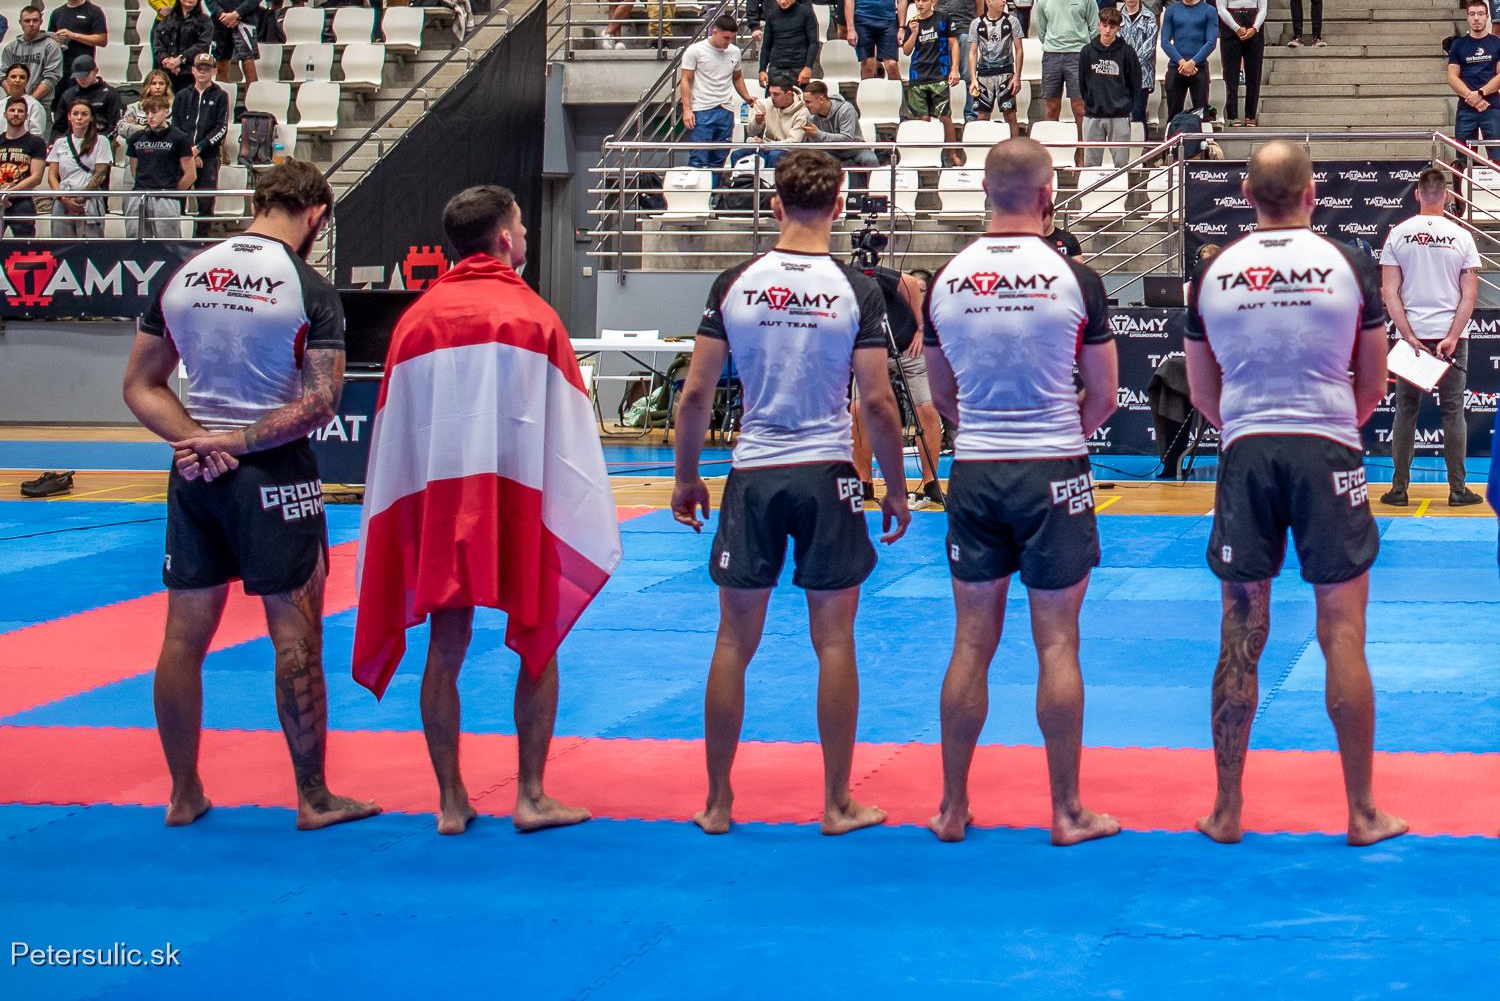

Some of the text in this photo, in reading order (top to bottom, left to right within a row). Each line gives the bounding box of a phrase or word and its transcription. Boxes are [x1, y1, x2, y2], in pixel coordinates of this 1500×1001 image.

[1189, 171, 1228, 180] TATAMY
[1338, 171, 1378, 180] TATAMY
[1389, 171, 1422, 180] TATAM
[1314, 197, 1352, 206] TATAMY
[1364, 197, 1403, 206] TATAMY
[1189, 224, 1228, 233] TATAMY
[1338, 224, 1378, 233] TATAMY
[1403, 234, 1455, 244] TATAMY
[185, 271, 286, 293] TATAMY
[1217, 267, 1333, 291] TATAMY
[946, 274, 1059, 295] TATAMY
[743, 289, 841, 309] TATAMY
[222, 303, 254, 312] TEAM
[1237, 302, 1265, 311] AUT
